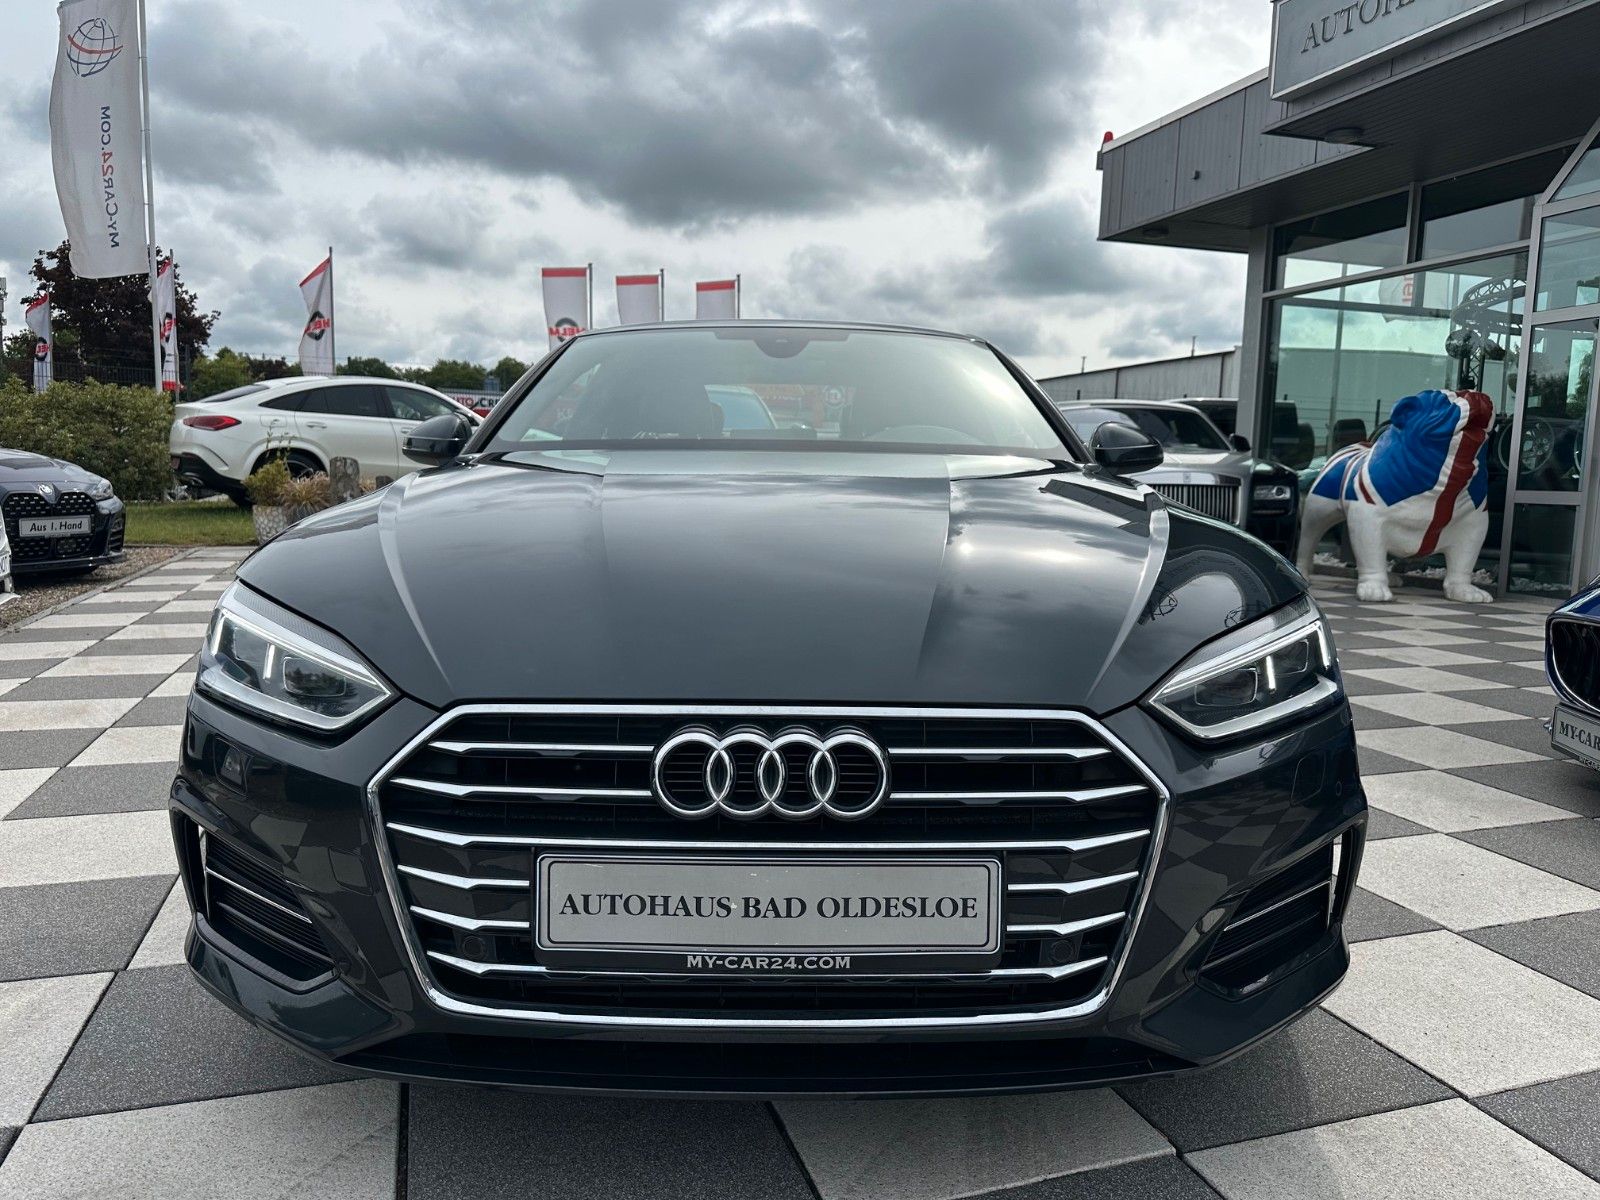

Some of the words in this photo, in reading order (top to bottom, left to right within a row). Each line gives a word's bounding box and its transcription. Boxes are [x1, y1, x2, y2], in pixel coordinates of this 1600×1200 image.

[30, 522, 47, 532] Aus
[60, 520, 83, 531] Hand
[559, 893, 732, 918] AUTOHAUS
[741, 896, 807, 919] BAD
[816, 896, 978, 919] OLDESLOE
[686, 955, 851, 970] MY-CAR24.COM
